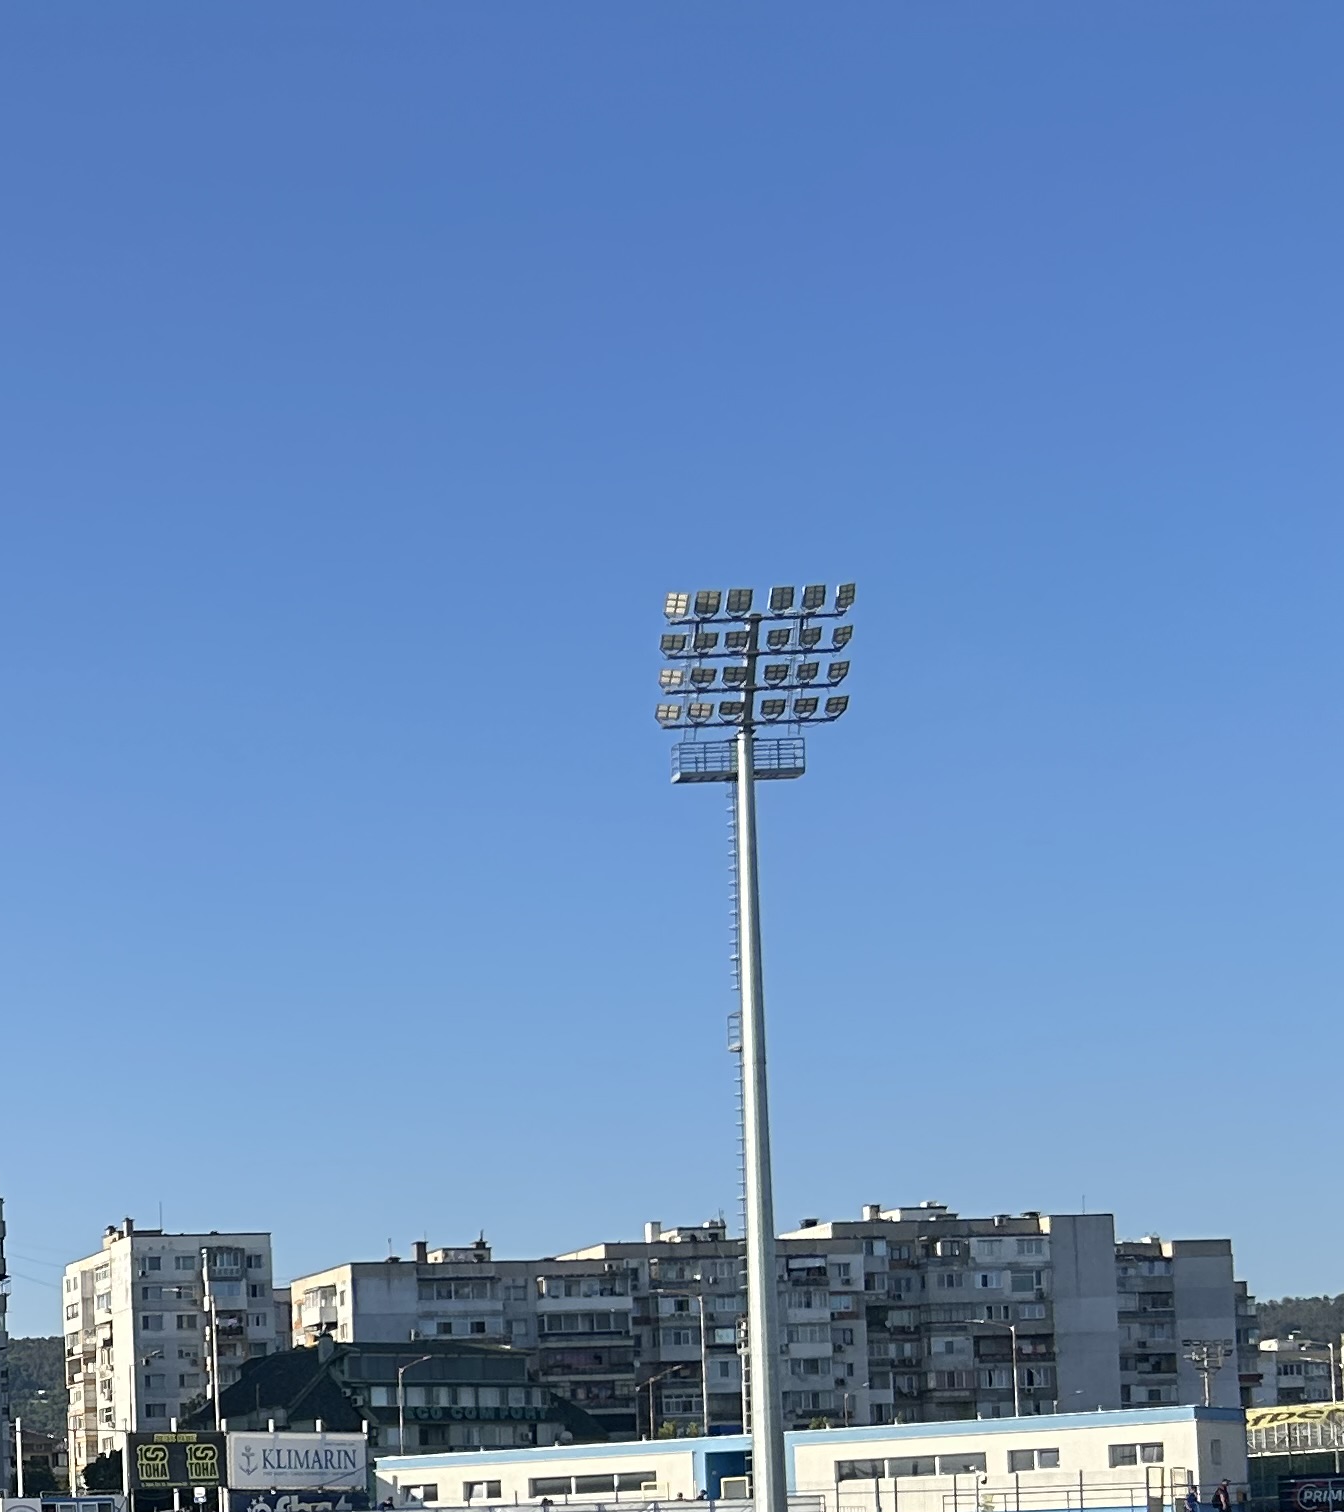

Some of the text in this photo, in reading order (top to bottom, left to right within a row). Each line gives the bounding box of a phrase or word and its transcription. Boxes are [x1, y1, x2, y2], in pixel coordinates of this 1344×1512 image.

[451, 1405, 548, 1420] COMFORT
[262, 1448, 357, 1470] KLIMARIN
[1303, 1489, 1344, 1503] PRIM
